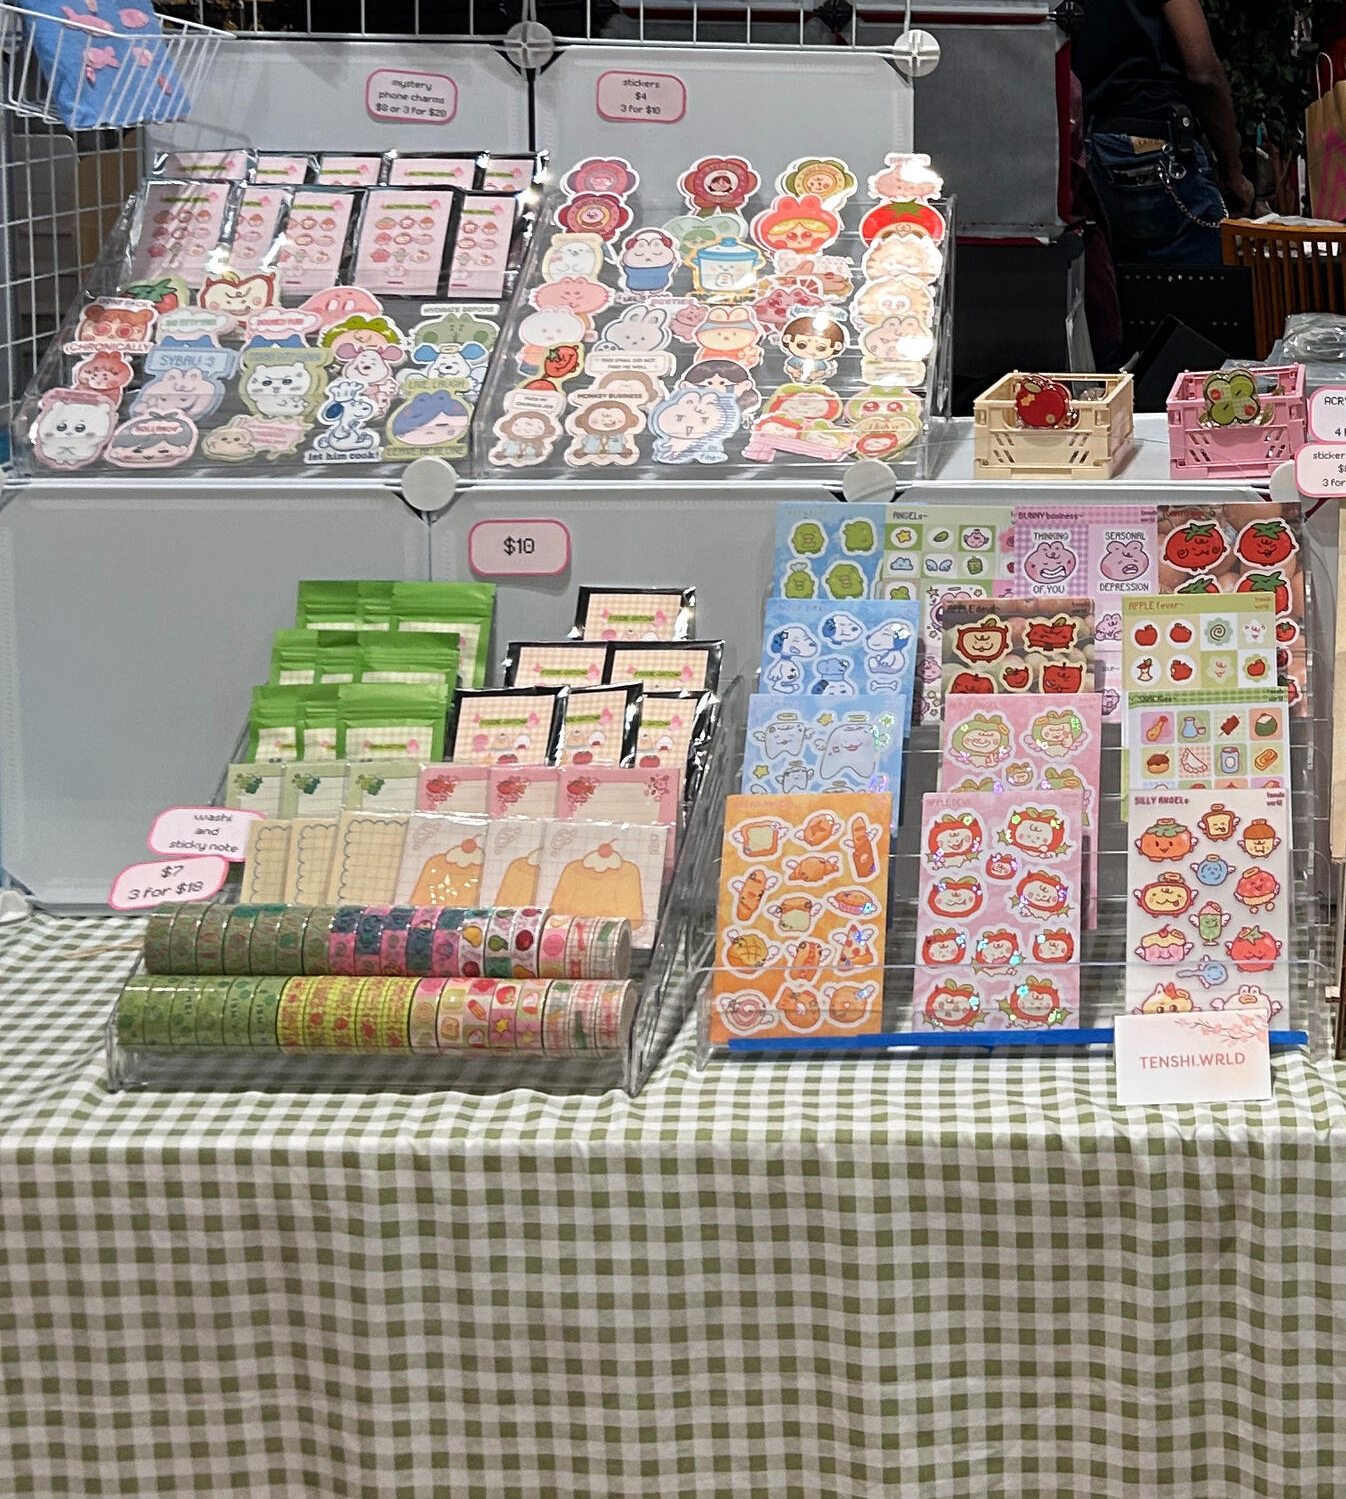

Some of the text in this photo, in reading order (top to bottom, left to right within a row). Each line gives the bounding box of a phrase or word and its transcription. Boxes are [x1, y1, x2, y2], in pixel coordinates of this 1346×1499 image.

[392, 80, 432, 91] mystery
[623, 79, 660, 88] stickers
[379, 92, 445, 104] phone charms
[635, 91, 647, 101] $4
[402, 106, 410, 114] 3
[411, 106, 427, 115] for
[620, 104, 627, 113] 3
[628, 104, 644, 114] for
[1334, 428, 1341, 437] 4
[1312, 451, 1346, 460] sticker
[1322, 478, 1329, 487] 3
[1330, 478, 1346, 487] for
[1105, 531, 1146, 541] SEASONAL
[503, 536, 535, 556] $10
[1033, 585, 1065, 594] OF YOU
[1099, 582, 1149, 592] DEPRESSION
[1128, 601, 1153, 611] APPLE
[1134, 796, 1156, 805] SILLY
[194, 813, 233, 822] washi
[195, 827, 219, 836] and
[168, 840, 239, 853] sticky note
[160, 864, 185, 879] $7
[128, 881, 204, 900] 3 for $18
[1140, 1051, 1246, 1070] TENSHI.WRLD
